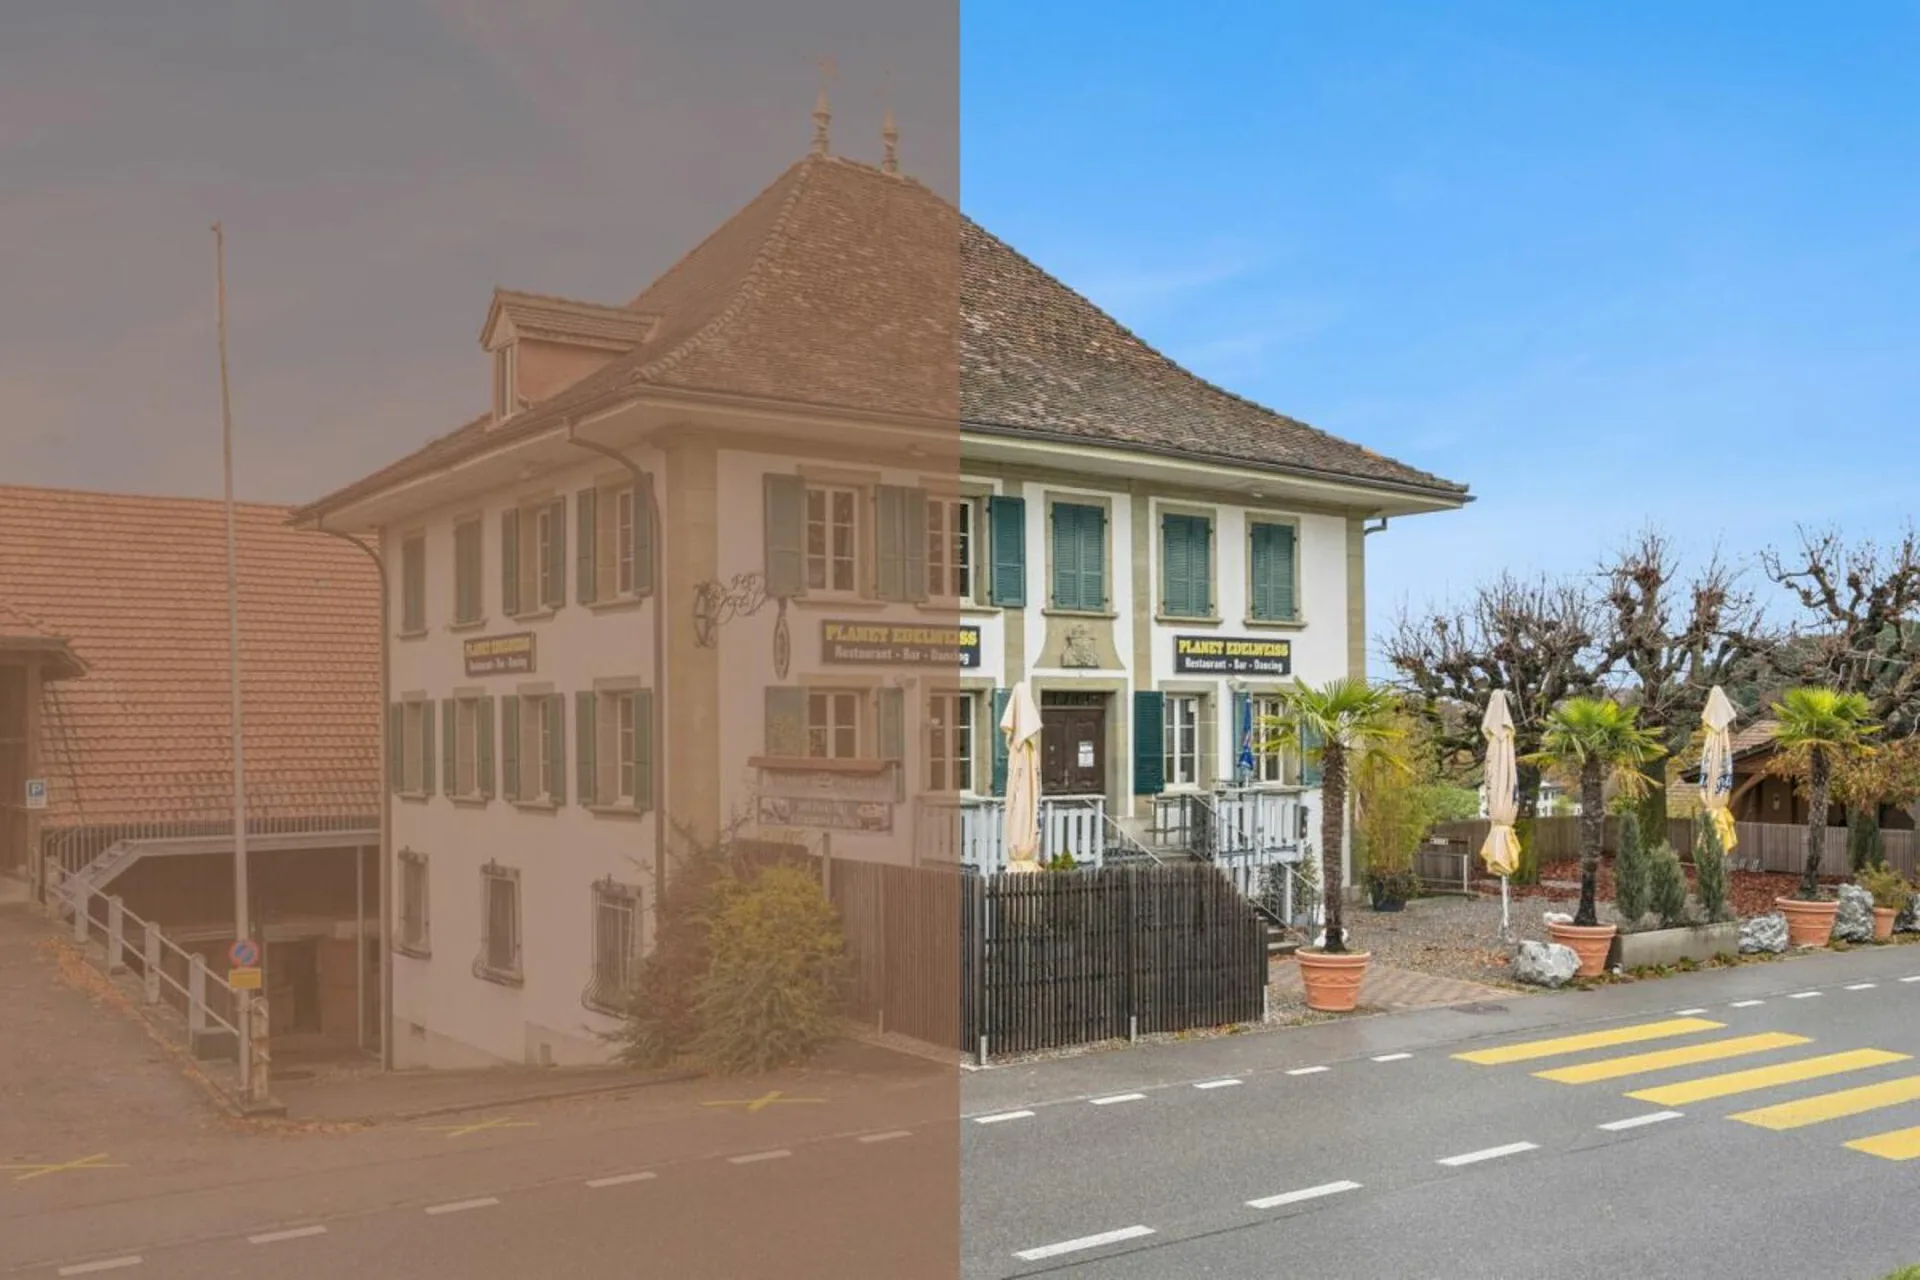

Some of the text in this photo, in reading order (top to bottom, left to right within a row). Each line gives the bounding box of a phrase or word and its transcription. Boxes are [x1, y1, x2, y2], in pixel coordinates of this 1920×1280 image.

[825, 624, 977, 646] PLANET EDELWEISS
[834, 644, 892, 660] Restaurant
[902, 647, 920, 661] Bar
[930, 648, 969, 665] Dancing
[1178, 639, 1288, 656] PLANET EDELWEISS
[1184, 657, 1227, 669] Restaurant
[1234, 658, 1247, 670] Bar
[1254, 659, 1283, 673] Dancing
[32, 784, 41, 795] P
